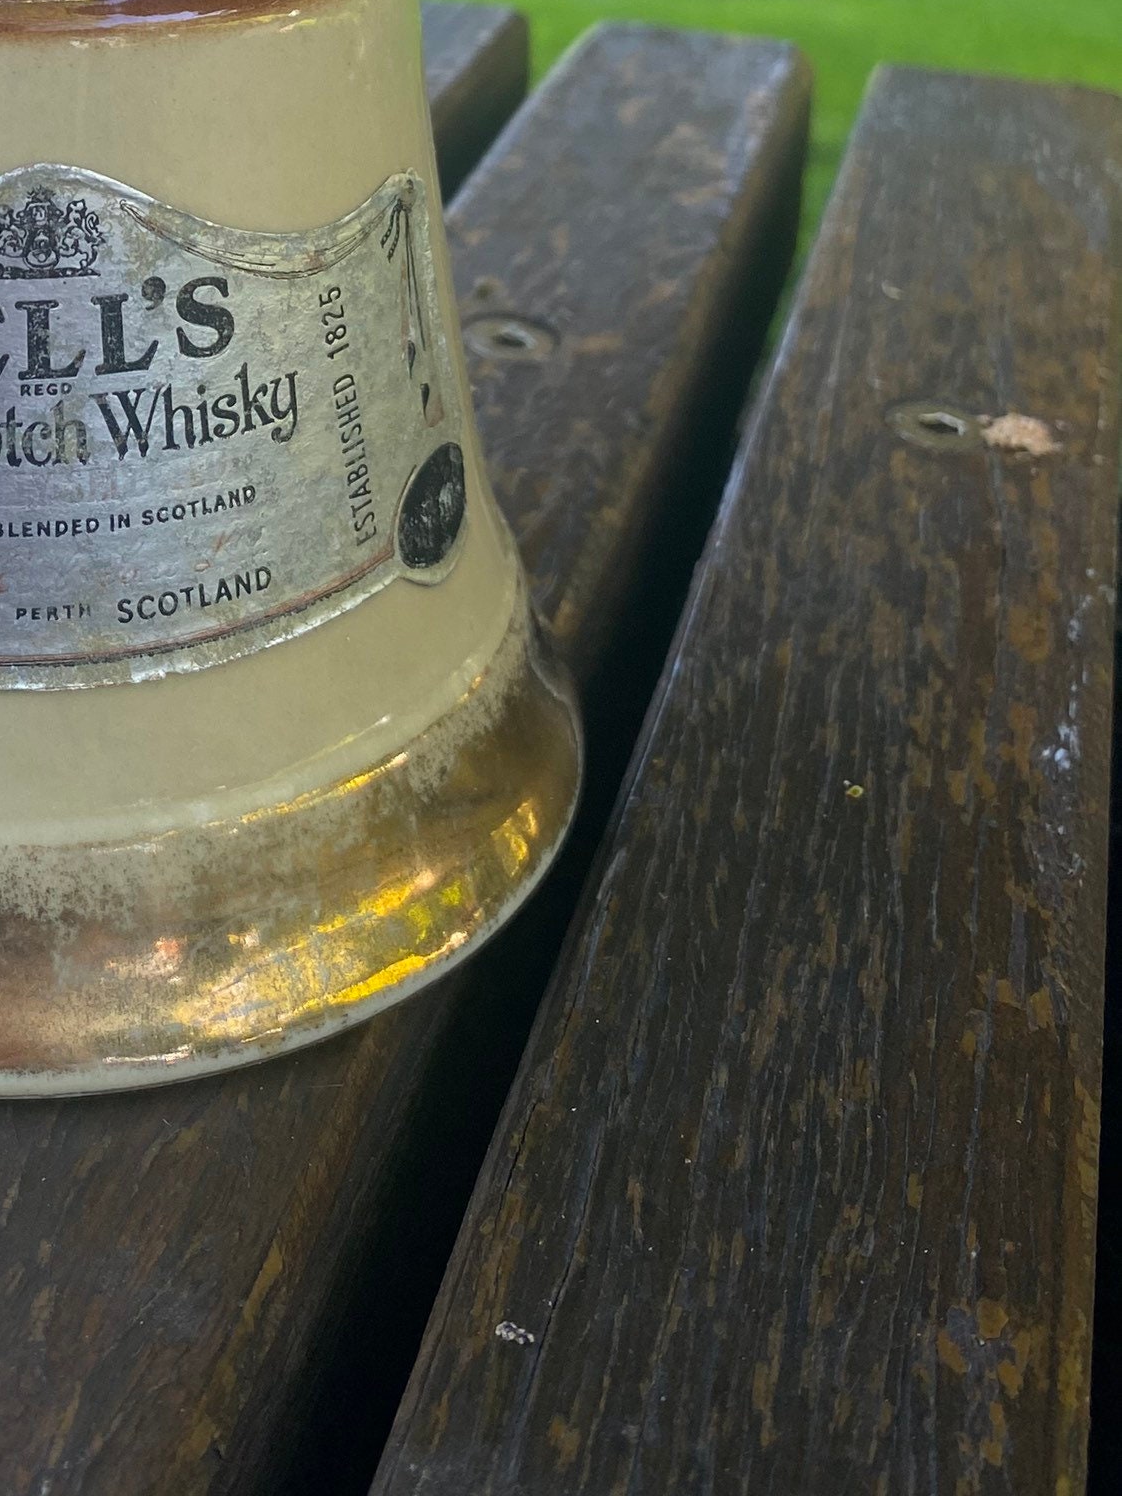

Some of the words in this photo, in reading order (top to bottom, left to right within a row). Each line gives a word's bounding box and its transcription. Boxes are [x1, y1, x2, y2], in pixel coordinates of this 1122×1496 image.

[319, 286, 350, 360] 1825
[20, 382, 72, 397] REGD
[88, 361, 299, 460] Whisky
[332, 373, 378, 547] ESTABLISHED
[109, 513, 131, 532] IN
[141, 485, 257, 526] SCOTLAND
[15, 603, 91, 622] PERTH
[116, 566, 272, 624] SCOTLAND
